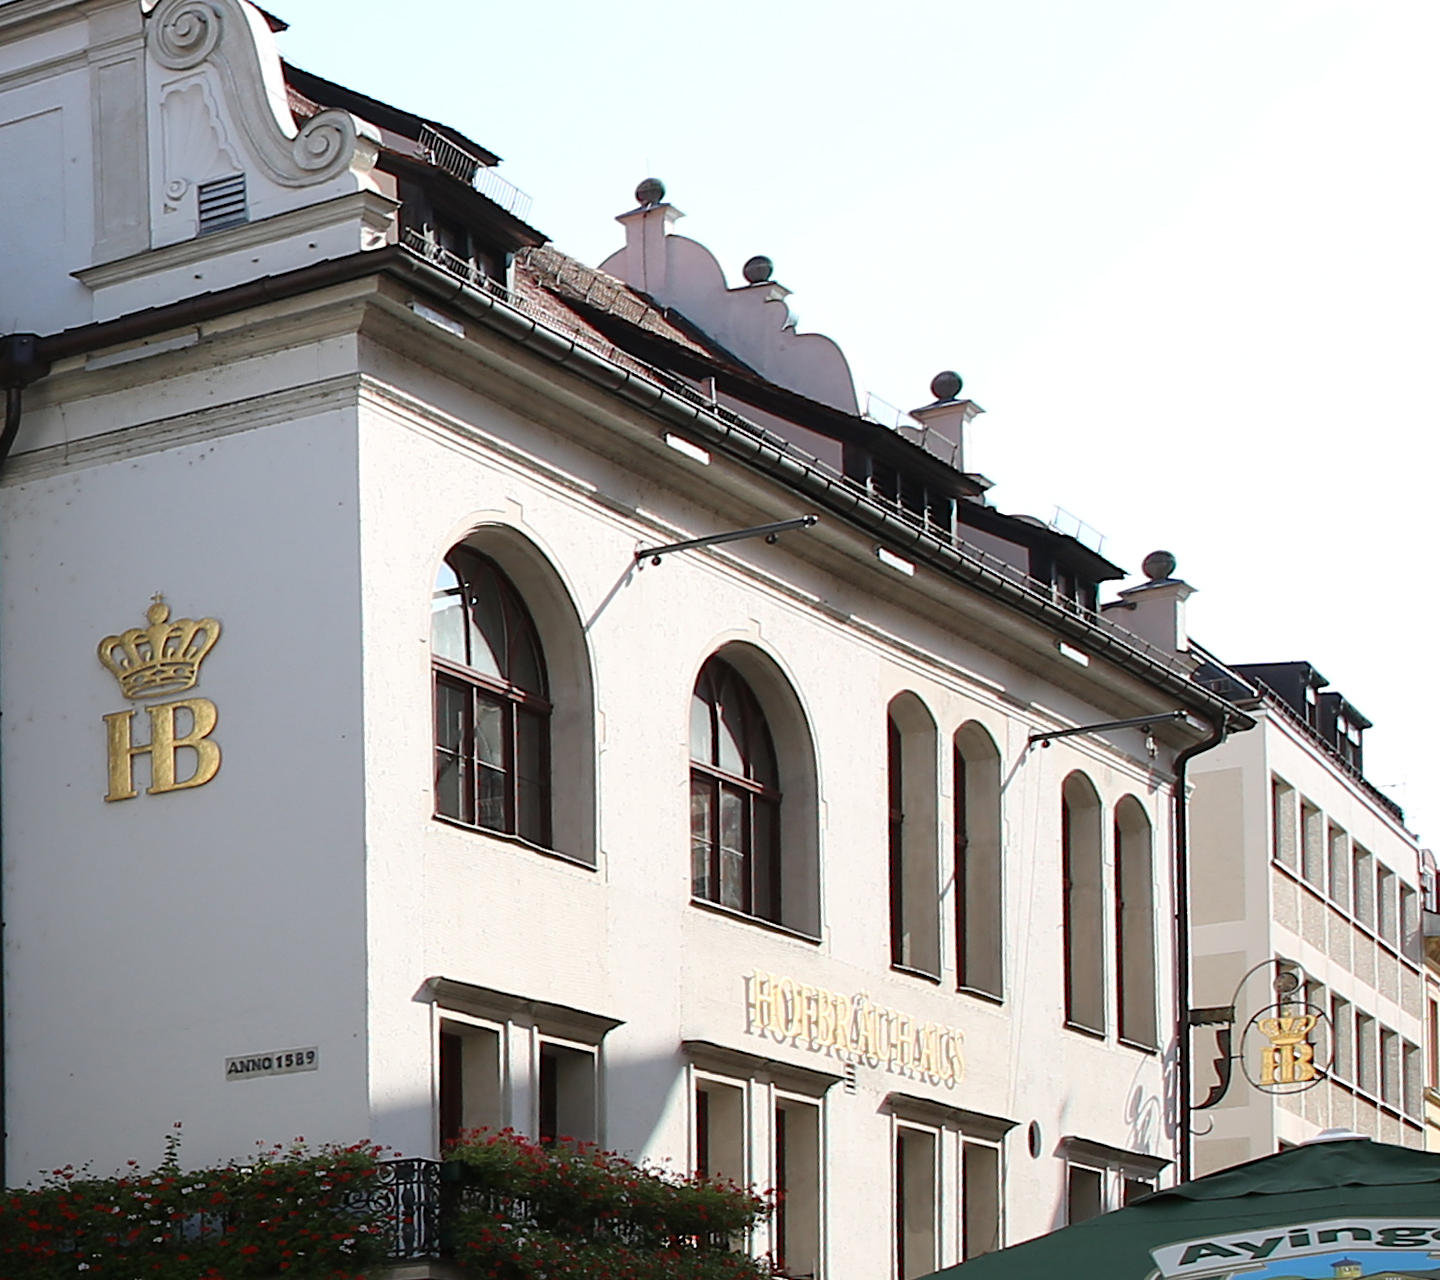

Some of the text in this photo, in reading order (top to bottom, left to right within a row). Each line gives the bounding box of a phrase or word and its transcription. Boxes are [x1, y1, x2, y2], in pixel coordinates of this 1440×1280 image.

[102, 697, 222, 803] HB
[752, 969, 967, 1085] HOFBRÄUHAUS
[227, 1050, 316, 1075] ANNO 1589
[1259, 1043, 1317, 1086] HB
[1178, 1226, 1440, 1267] Aying
